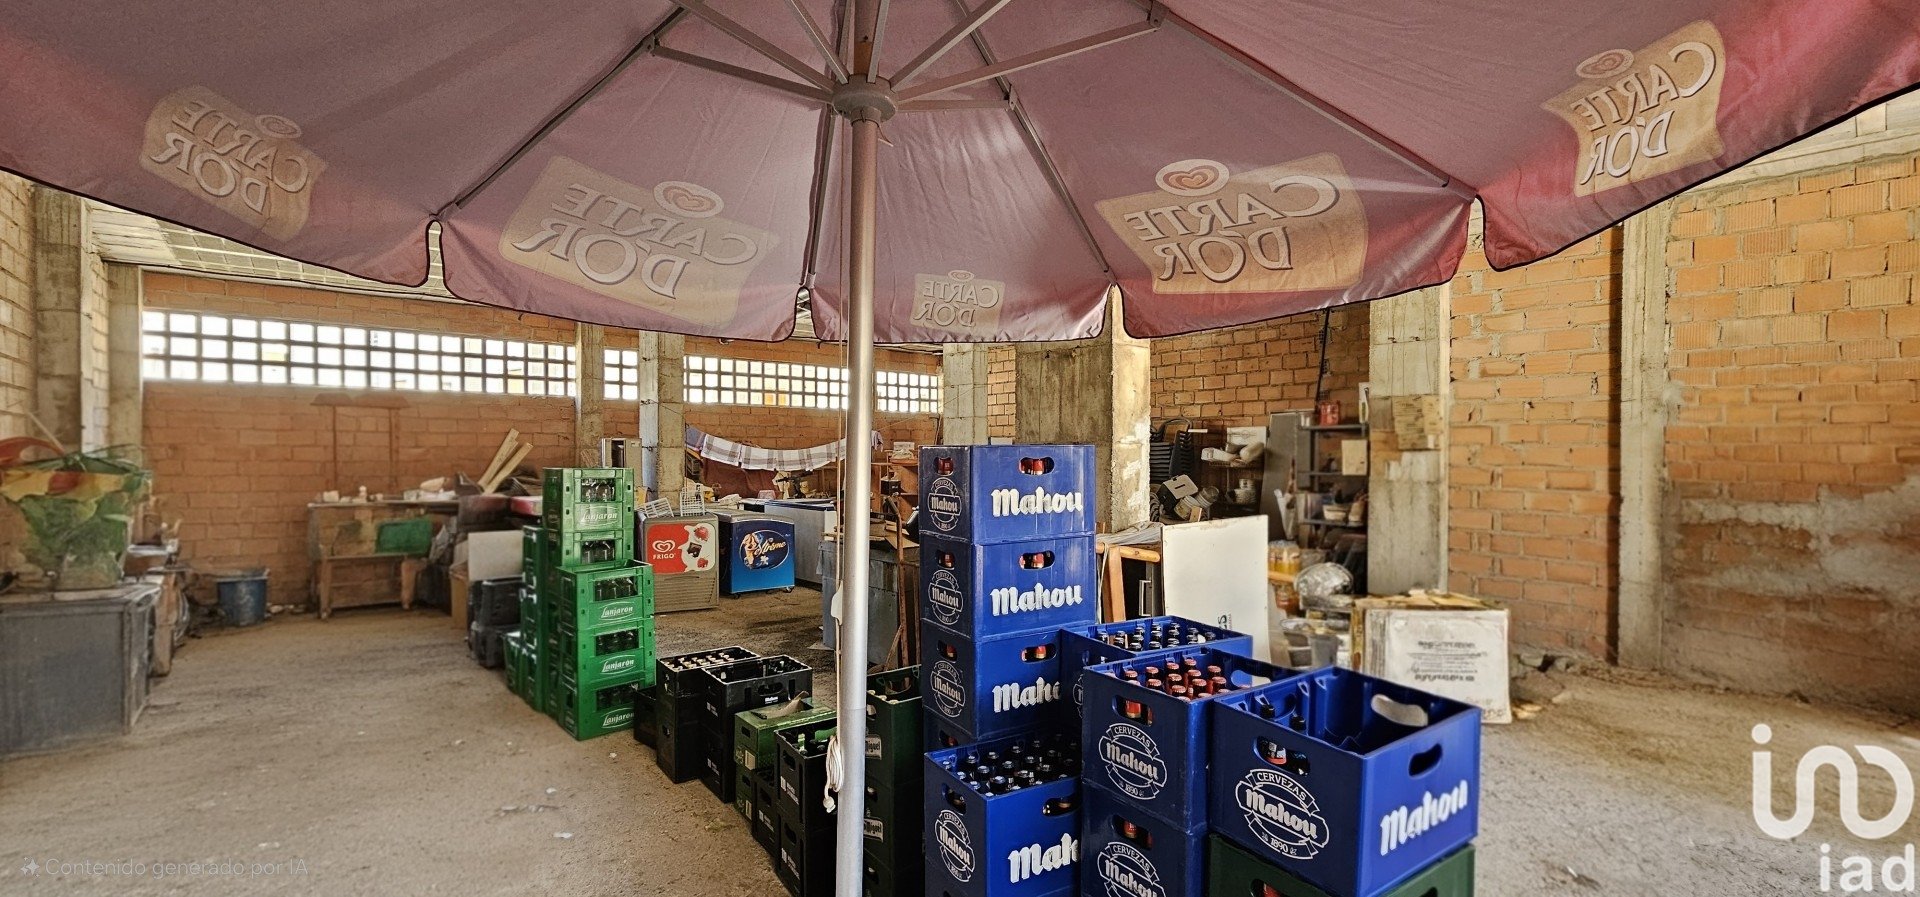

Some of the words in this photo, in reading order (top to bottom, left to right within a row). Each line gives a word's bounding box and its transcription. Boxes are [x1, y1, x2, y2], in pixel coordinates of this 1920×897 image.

[931, 496, 958, 512] Mahou
[990, 486, 1083, 517] Mahou
[931, 587, 959, 608] Mahou
[989, 582, 1083, 617] Mahou
[934, 675, 962, 702] Mahou
[1114, 726, 1151, 747] CERVEZAS
[1106, 742, 1158, 780] Mahou
[1256, 772, 1307, 801] CERVEZAS
[1245, 788, 1318, 839] Mahou
[1380, 779, 1468, 856] Mahou
[939, 825, 971, 866] Mahou
[1112, 845, 1151, 871] CERVEZAS
[1270, 837, 1289, 853] 1890
